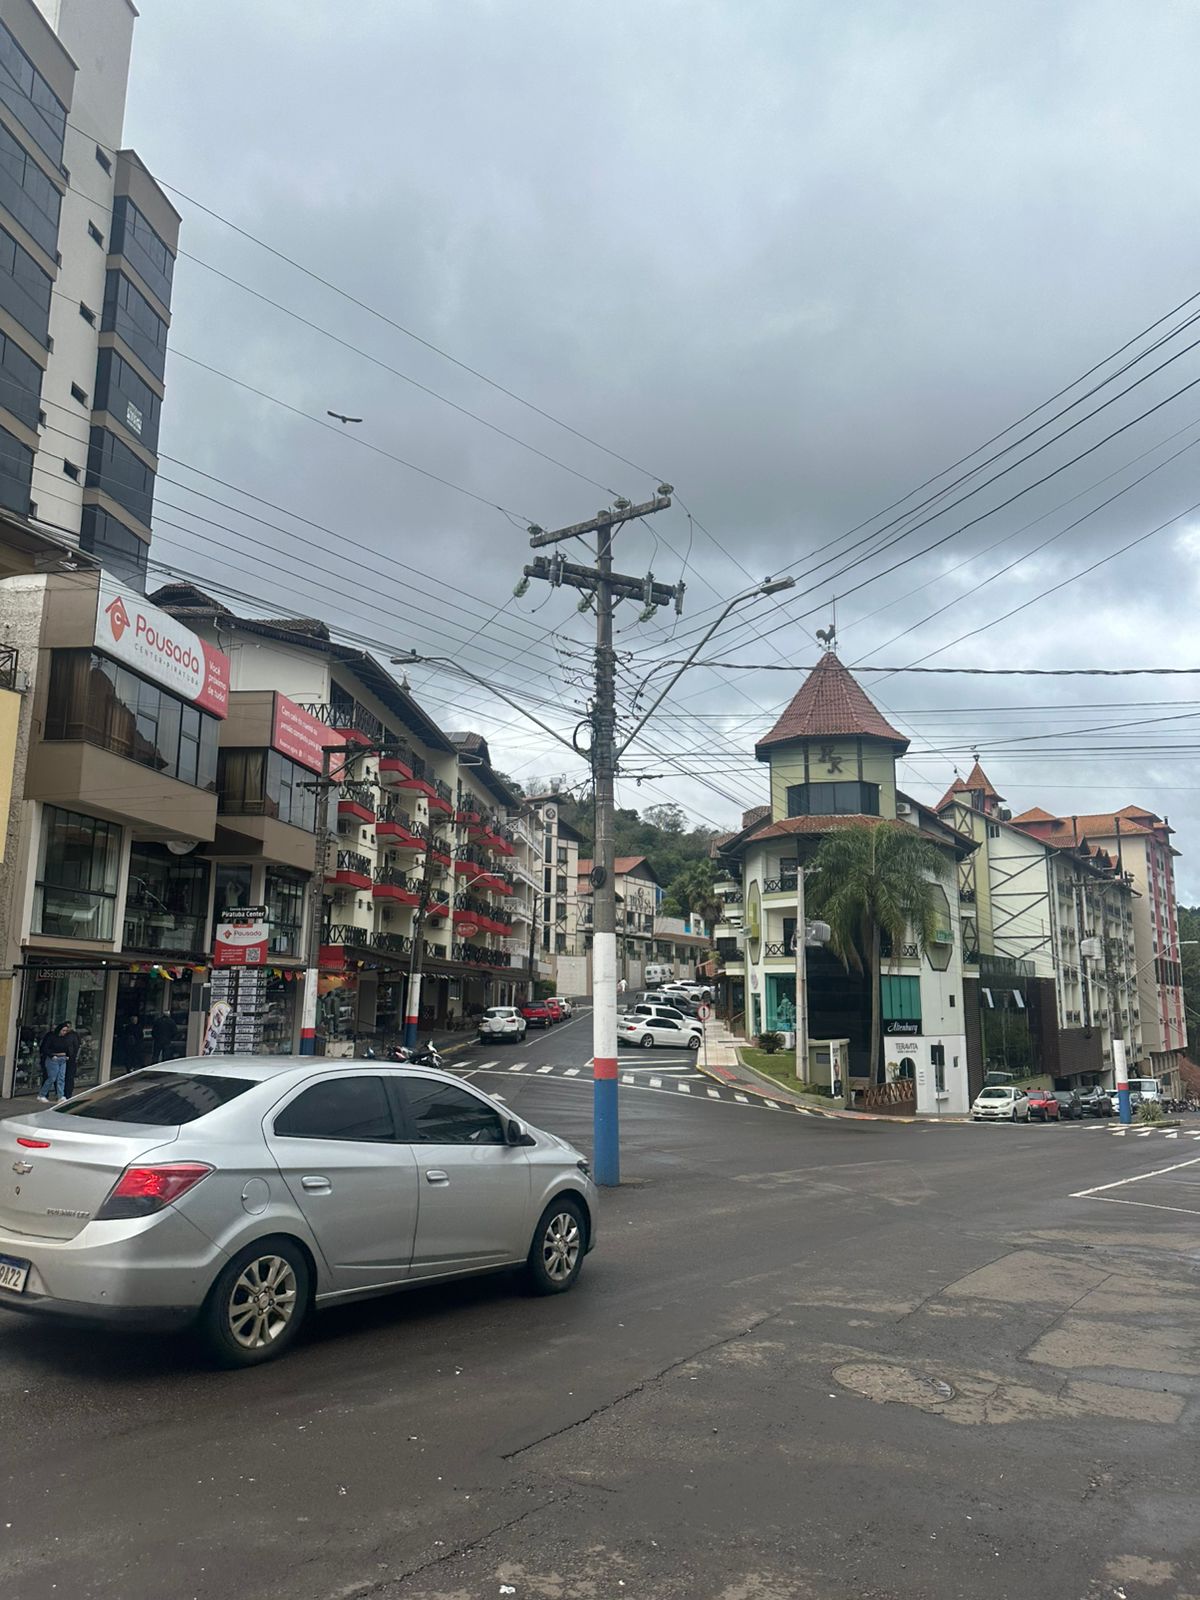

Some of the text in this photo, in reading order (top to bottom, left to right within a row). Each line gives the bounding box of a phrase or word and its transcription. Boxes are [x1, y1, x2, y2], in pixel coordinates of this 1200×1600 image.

[136, 614, 199, 676] Pousada
[209, 660, 220, 675] Você
[208, 685, 214, 696] de
